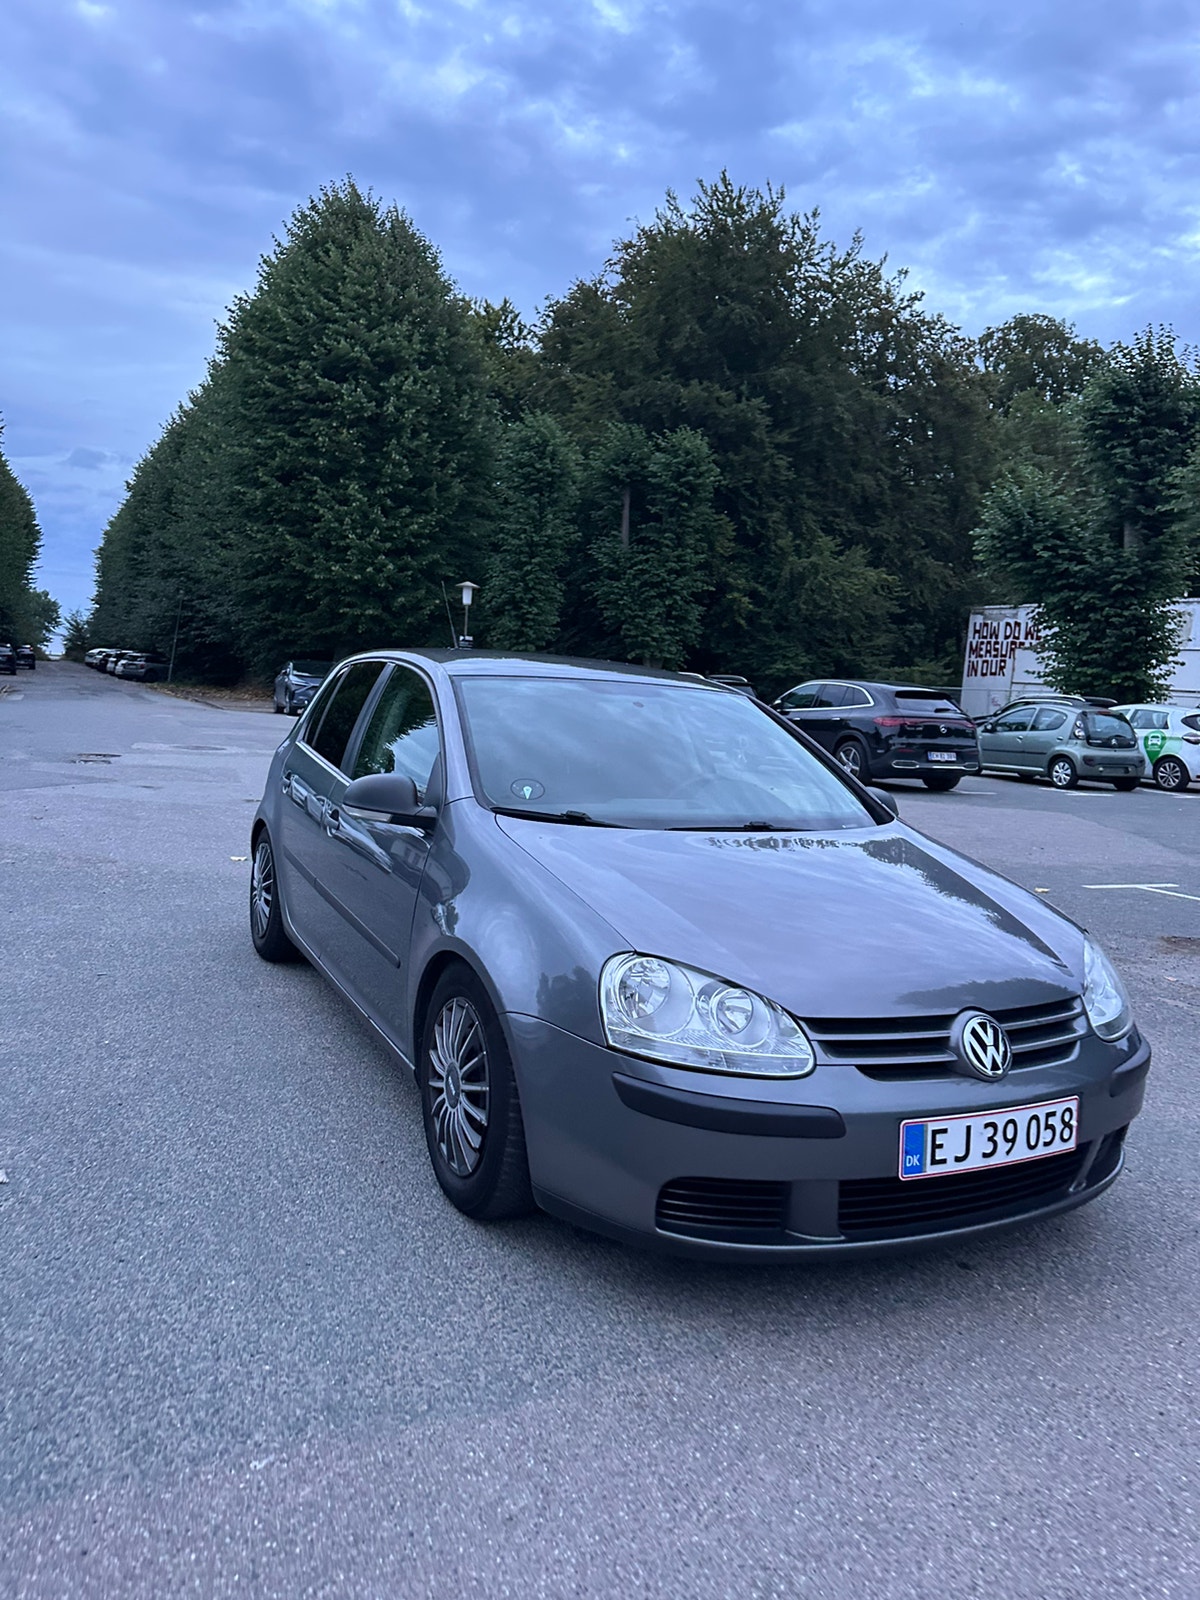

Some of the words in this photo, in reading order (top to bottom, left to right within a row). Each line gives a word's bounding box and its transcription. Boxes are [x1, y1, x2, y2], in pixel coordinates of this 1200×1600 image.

[972, 621, 1000, 640] HOW
[1003, 621, 1022, 641] DO
[980, 659, 1007, 677] OUR
[930, 1124, 972, 1166] EJ
[982, 1118, 1018, 1159] 39
[1026, 1106, 1074, 1151] 058
[905, 1154, 920, 1167] DK
